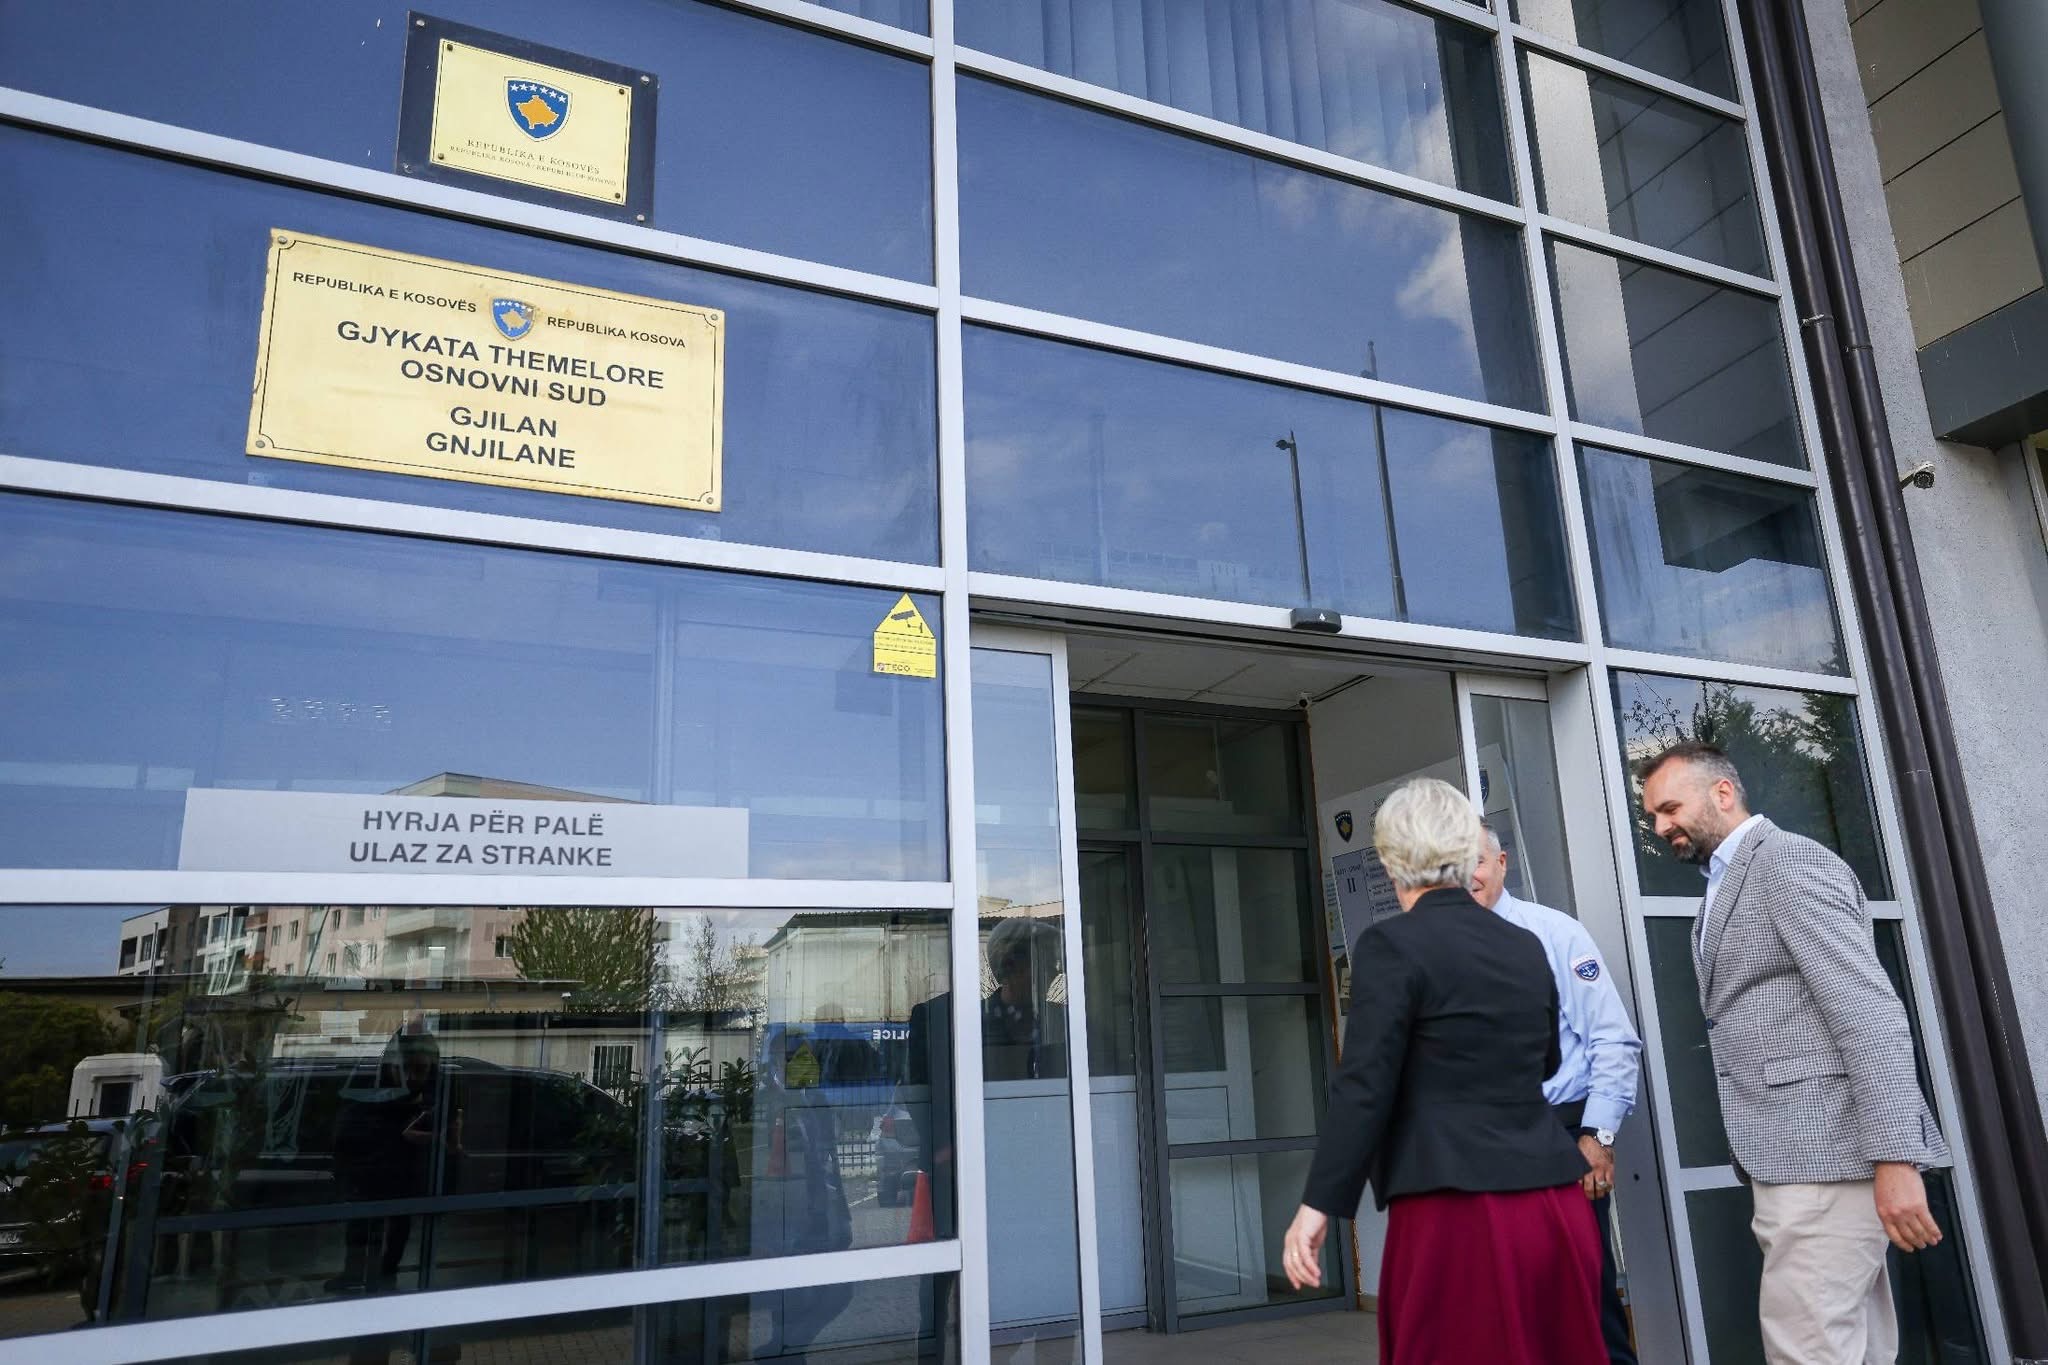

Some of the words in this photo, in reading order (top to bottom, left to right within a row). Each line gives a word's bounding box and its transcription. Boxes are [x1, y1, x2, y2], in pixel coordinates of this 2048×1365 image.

[293, 271, 384, 298] REPUBLIKA
[390, 289, 399, 300] E
[404, 291, 477, 313] KOSOVËS
[547, 316, 627, 339] REPUBLIKA
[631, 330, 686, 348] KOSOVA
[337, 320, 480, 361] GJYKATA
[488, 344, 665, 389] THEMELORE
[401, 359, 538, 398] OSNOVNI
[547, 381, 607, 407] SUD
[450, 406, 557, 438] GJILAN
[426, 432, 576, 469] GNJILANE
[363, 810, 460, 832] HYRJA
[469, 810, 525, 834] PËR
[534, 813, 604, 836] PALË
[350, 842, 427, 863] ULAZ
[436, 844, 473, 864] ZA
[481, 845, 612, 867] STRANKE
